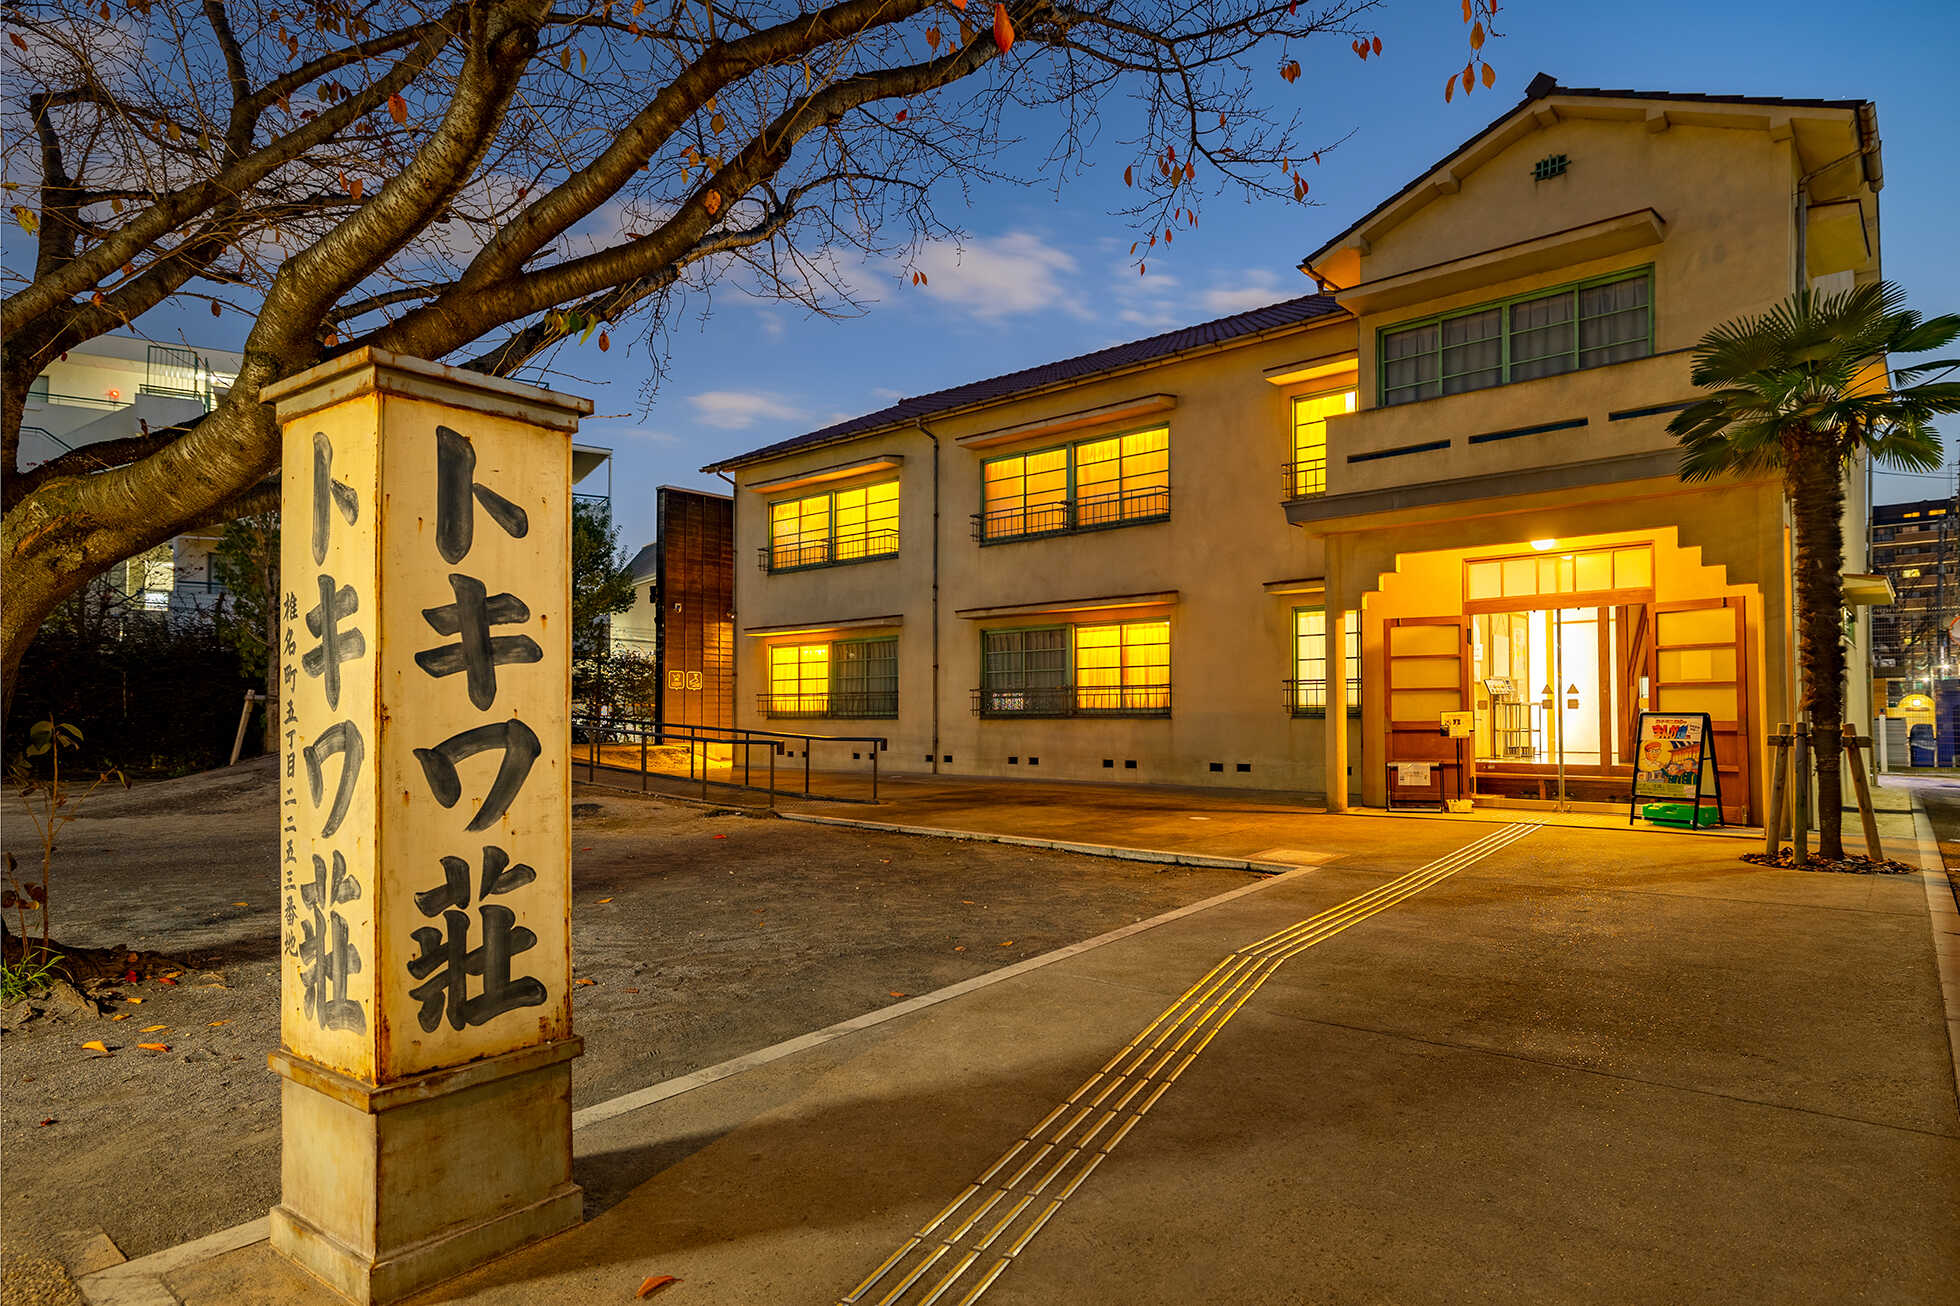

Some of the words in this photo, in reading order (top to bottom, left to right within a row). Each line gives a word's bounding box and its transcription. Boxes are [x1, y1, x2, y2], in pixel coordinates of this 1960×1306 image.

[283, 591, 299, 958] 椎名町五丁目二二五三番地
[300, 431, 367, 1034] トキワ荘
[408, 424, 549, 1032] トキワ荘
